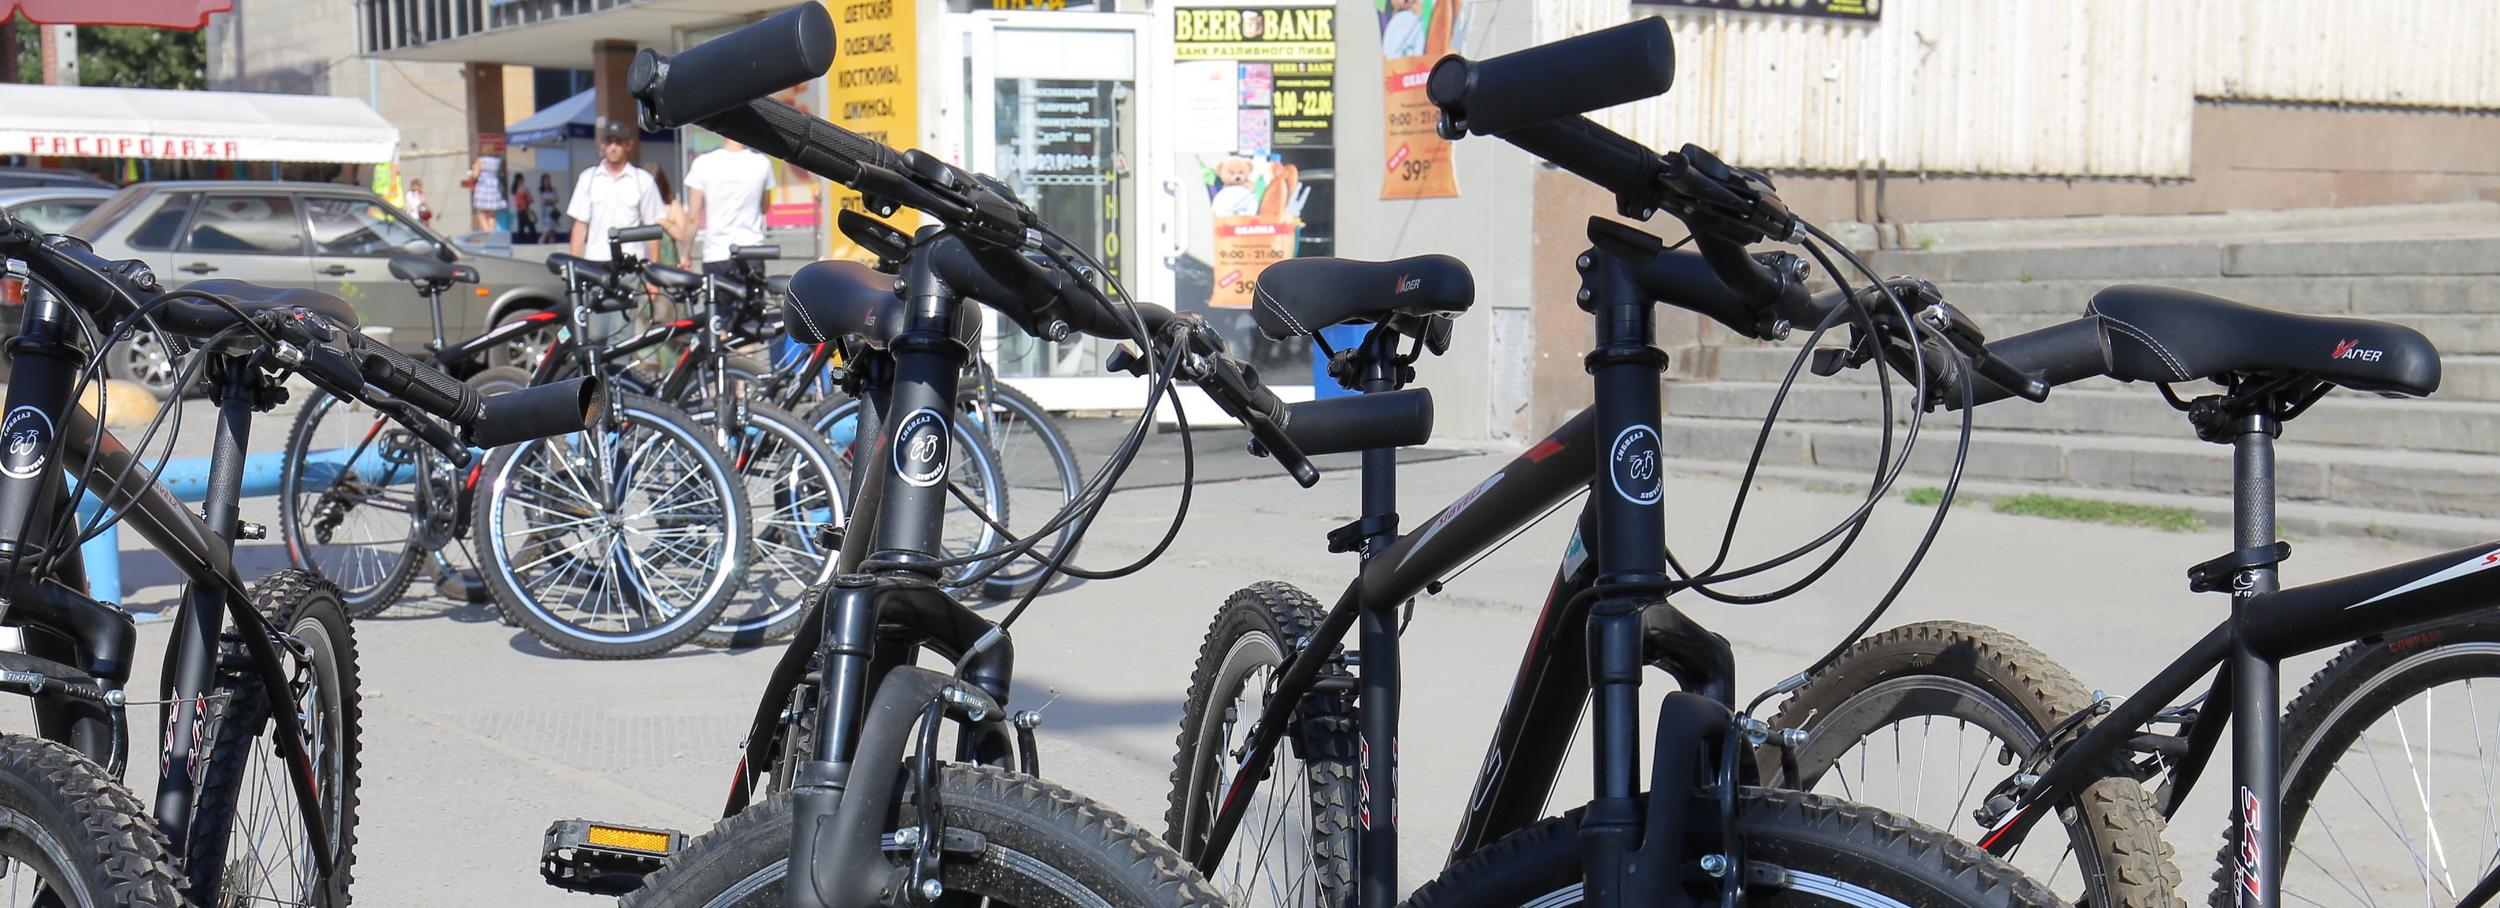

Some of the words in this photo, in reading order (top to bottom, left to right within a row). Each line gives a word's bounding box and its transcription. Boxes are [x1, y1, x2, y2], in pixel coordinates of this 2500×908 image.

[845, 0, 893, 23] ДЕТСКАЯ
[1175, 9, 1243, 41] BEER
[1262, 9, 1333, 41] BANK
[1177, 46, 1209, 56] БАНК
[1213, 46, 1294, 56] РАЗЛИВНОГО
[1298, 46, 1331, 56] ПИВА
[29, 136, 240, 159] РАСПРОДАЖА
[2331, 338, 2384, 362] VADER
[2241, 786, 2262, 904] 541
